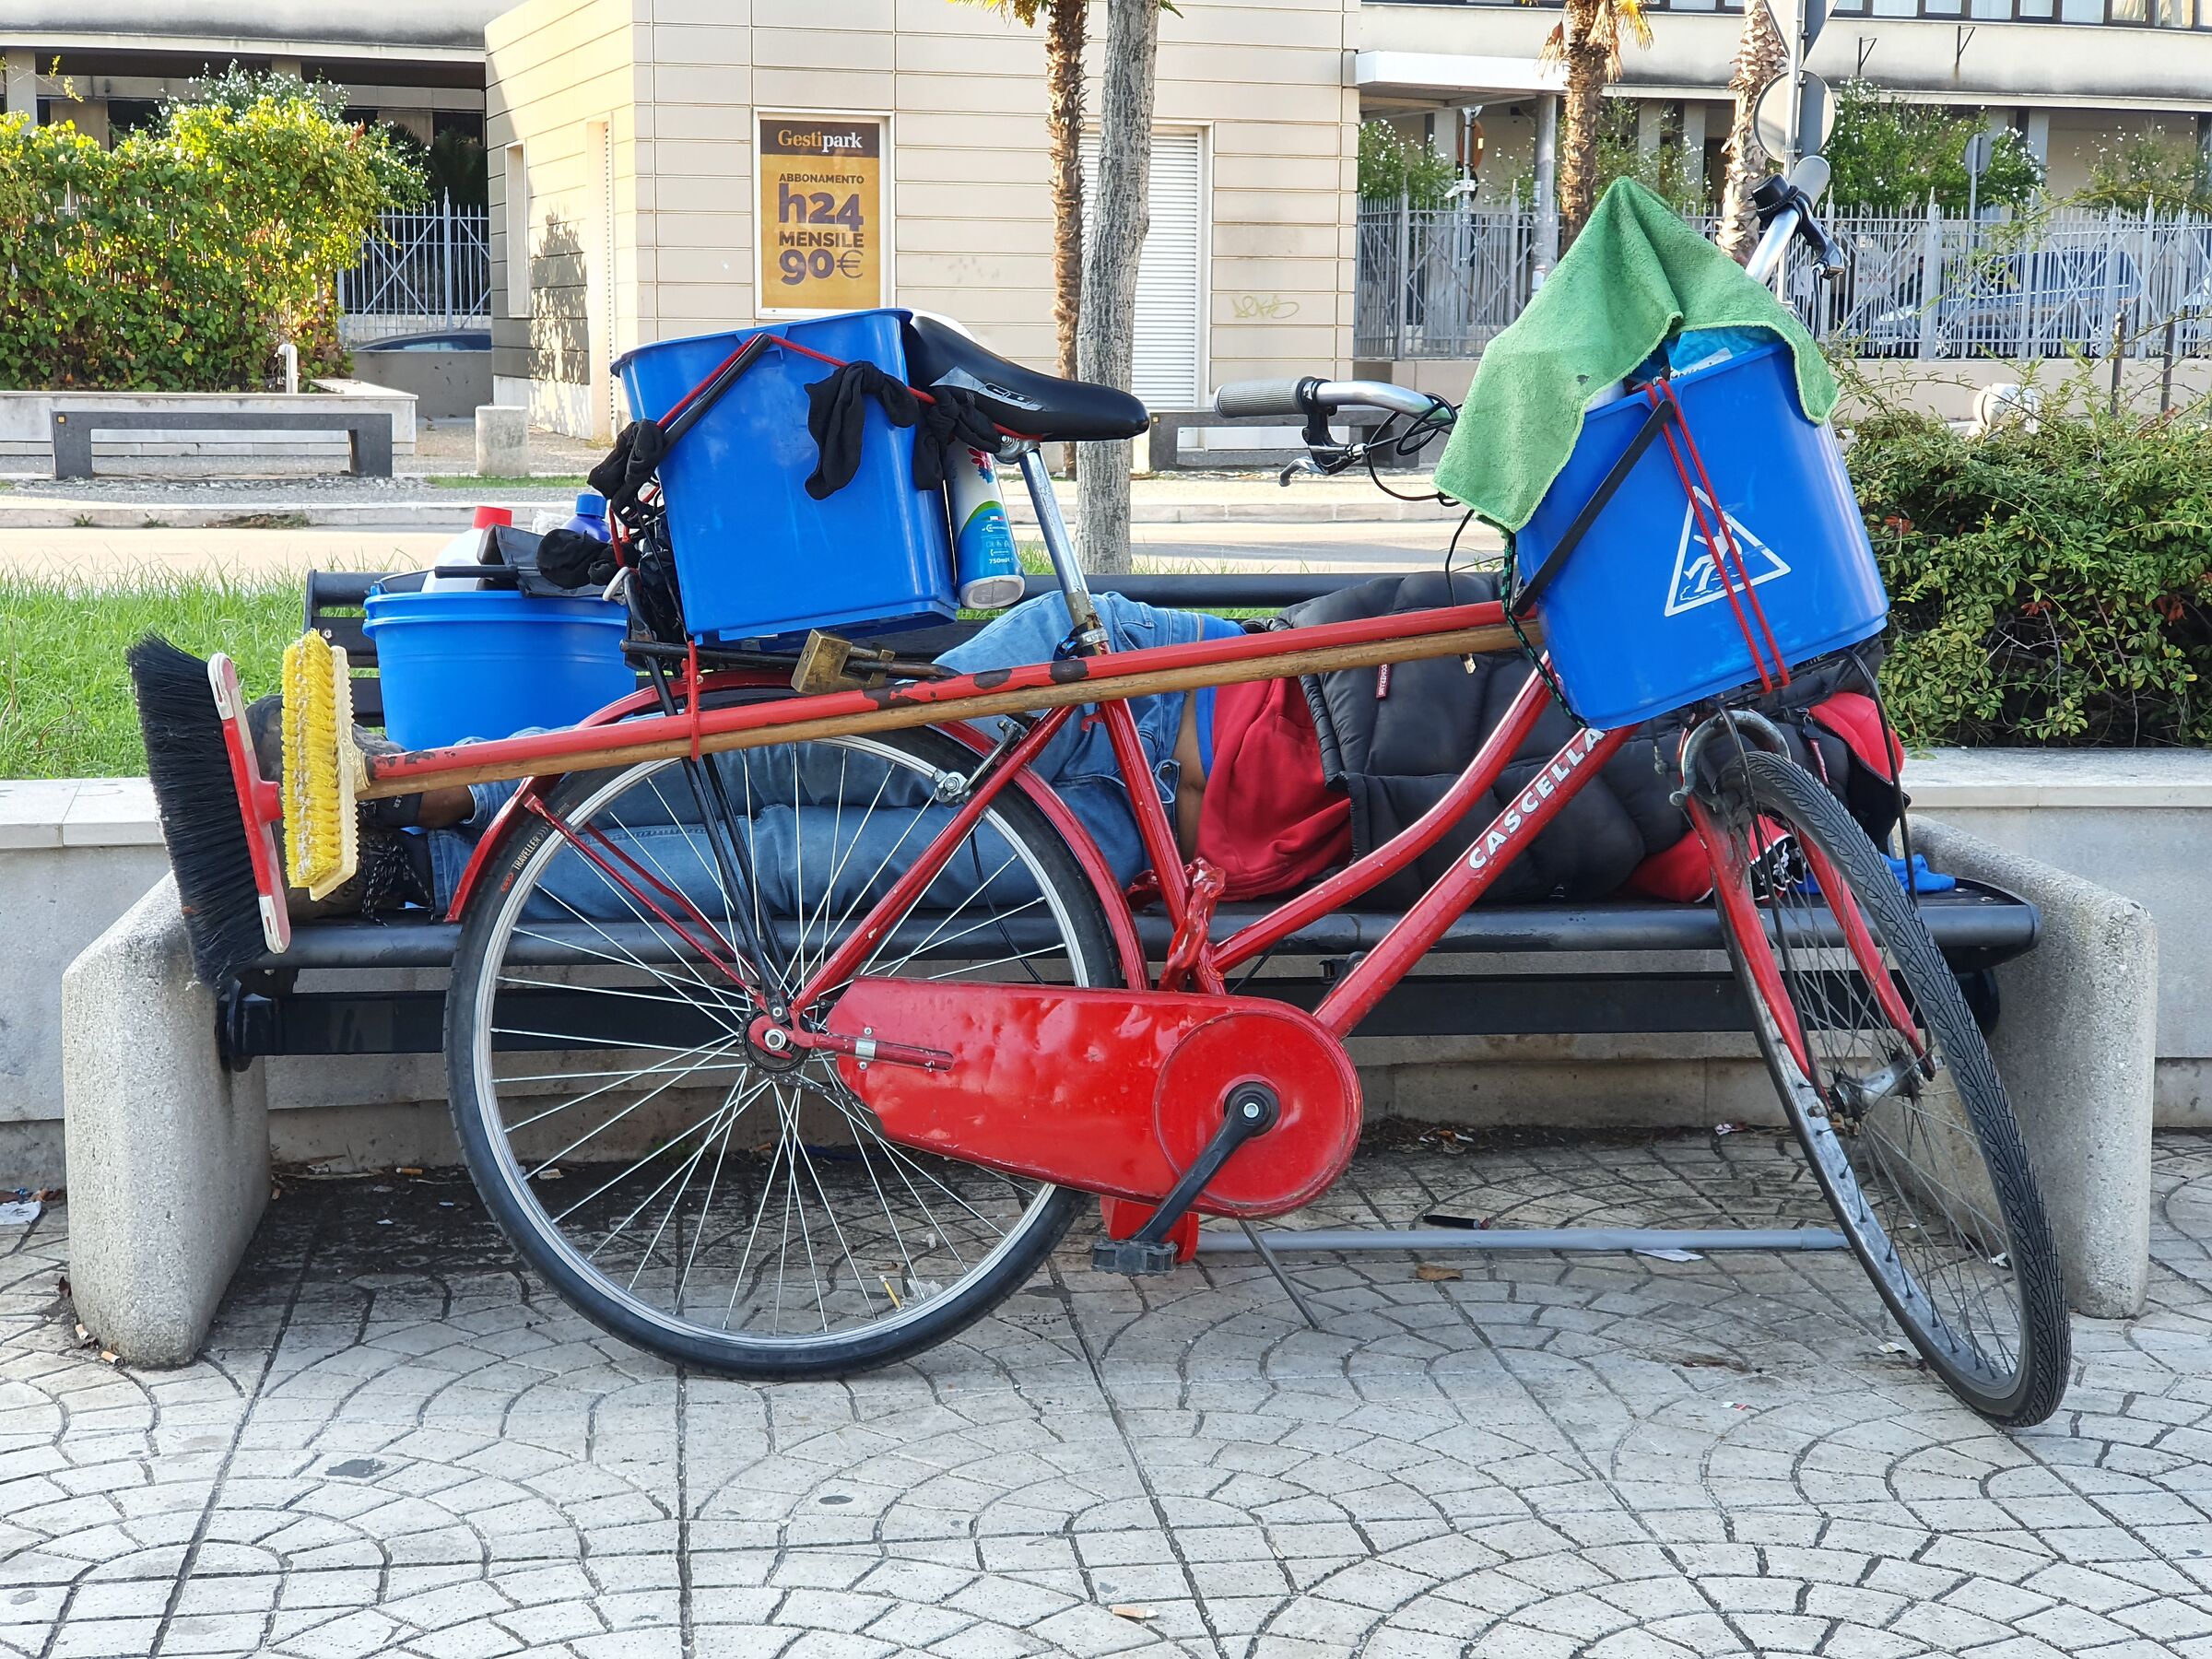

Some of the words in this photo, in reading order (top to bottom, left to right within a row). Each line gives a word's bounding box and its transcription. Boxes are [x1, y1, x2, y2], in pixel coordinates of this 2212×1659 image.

[778, 129, 863, 152] Gestipark
[779, 173, 865, 184] ABBONAMENTO
[778, 182, 865, 231] h24
[779, 230, 865, 248] MENSILE
[779, 248, 864, 286] 90€
[1468, 727, 1606, 869] CASCELLA
[512, 835, 542, 870] TRAVELLER
